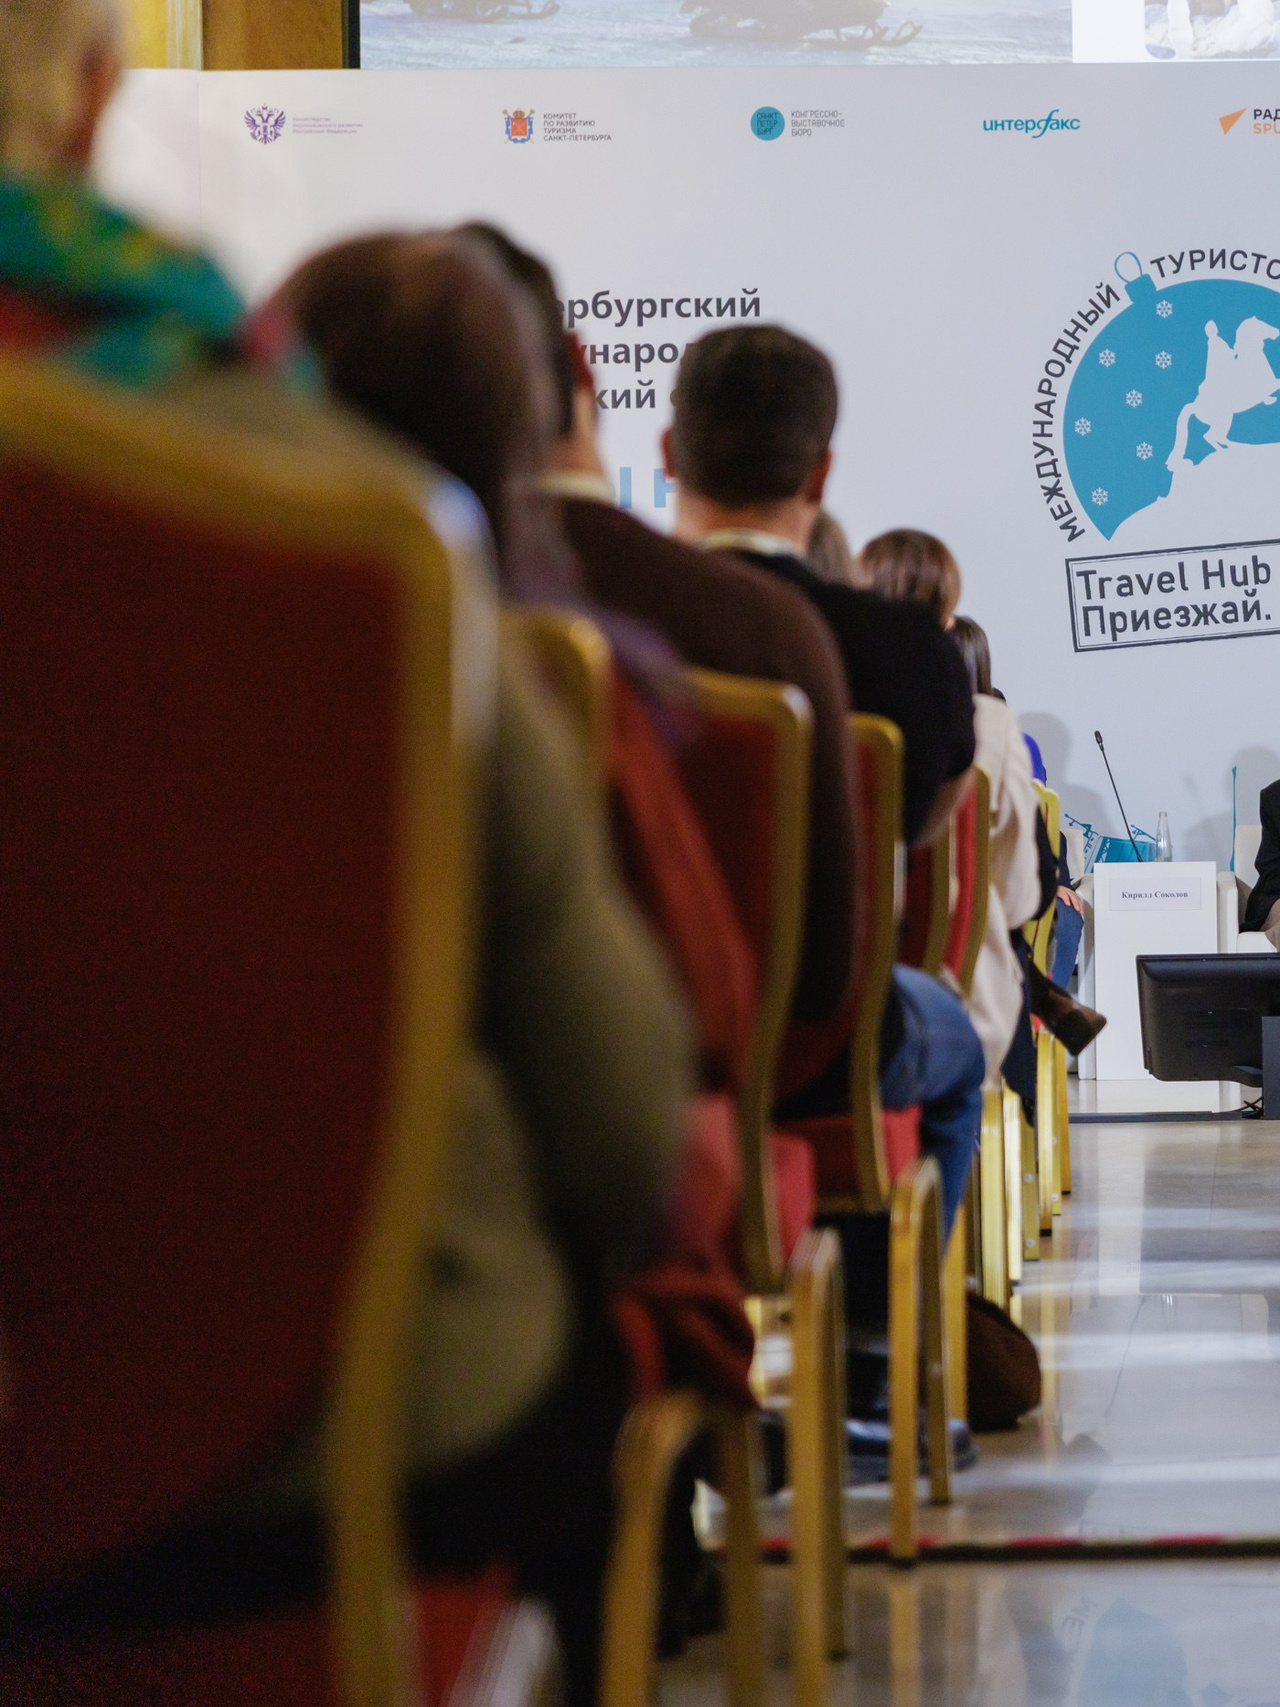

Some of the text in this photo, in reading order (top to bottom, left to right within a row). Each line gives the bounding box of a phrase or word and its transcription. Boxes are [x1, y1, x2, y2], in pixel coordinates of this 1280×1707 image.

[791, 110, 842, 118] КОНГРЕССНО-
[791, 119, 845, 127] ВЫСТАВОЧНОЕ
[983, 109, 1080, 138] интерфакс
[791, 128, 812, 137] БЮРО
[556, 288, 761, 329] рбургский
[1032, 282, 1121, 542] МЕЖДУНАРОДНЫЙ
[1076, 561, 1189, 600] Travel
[1202, 555, 1271, 589] Hub
[1082, 588, 1272, 641] Приезжай.
[1122, 891, 1152, 900] Кирилл
